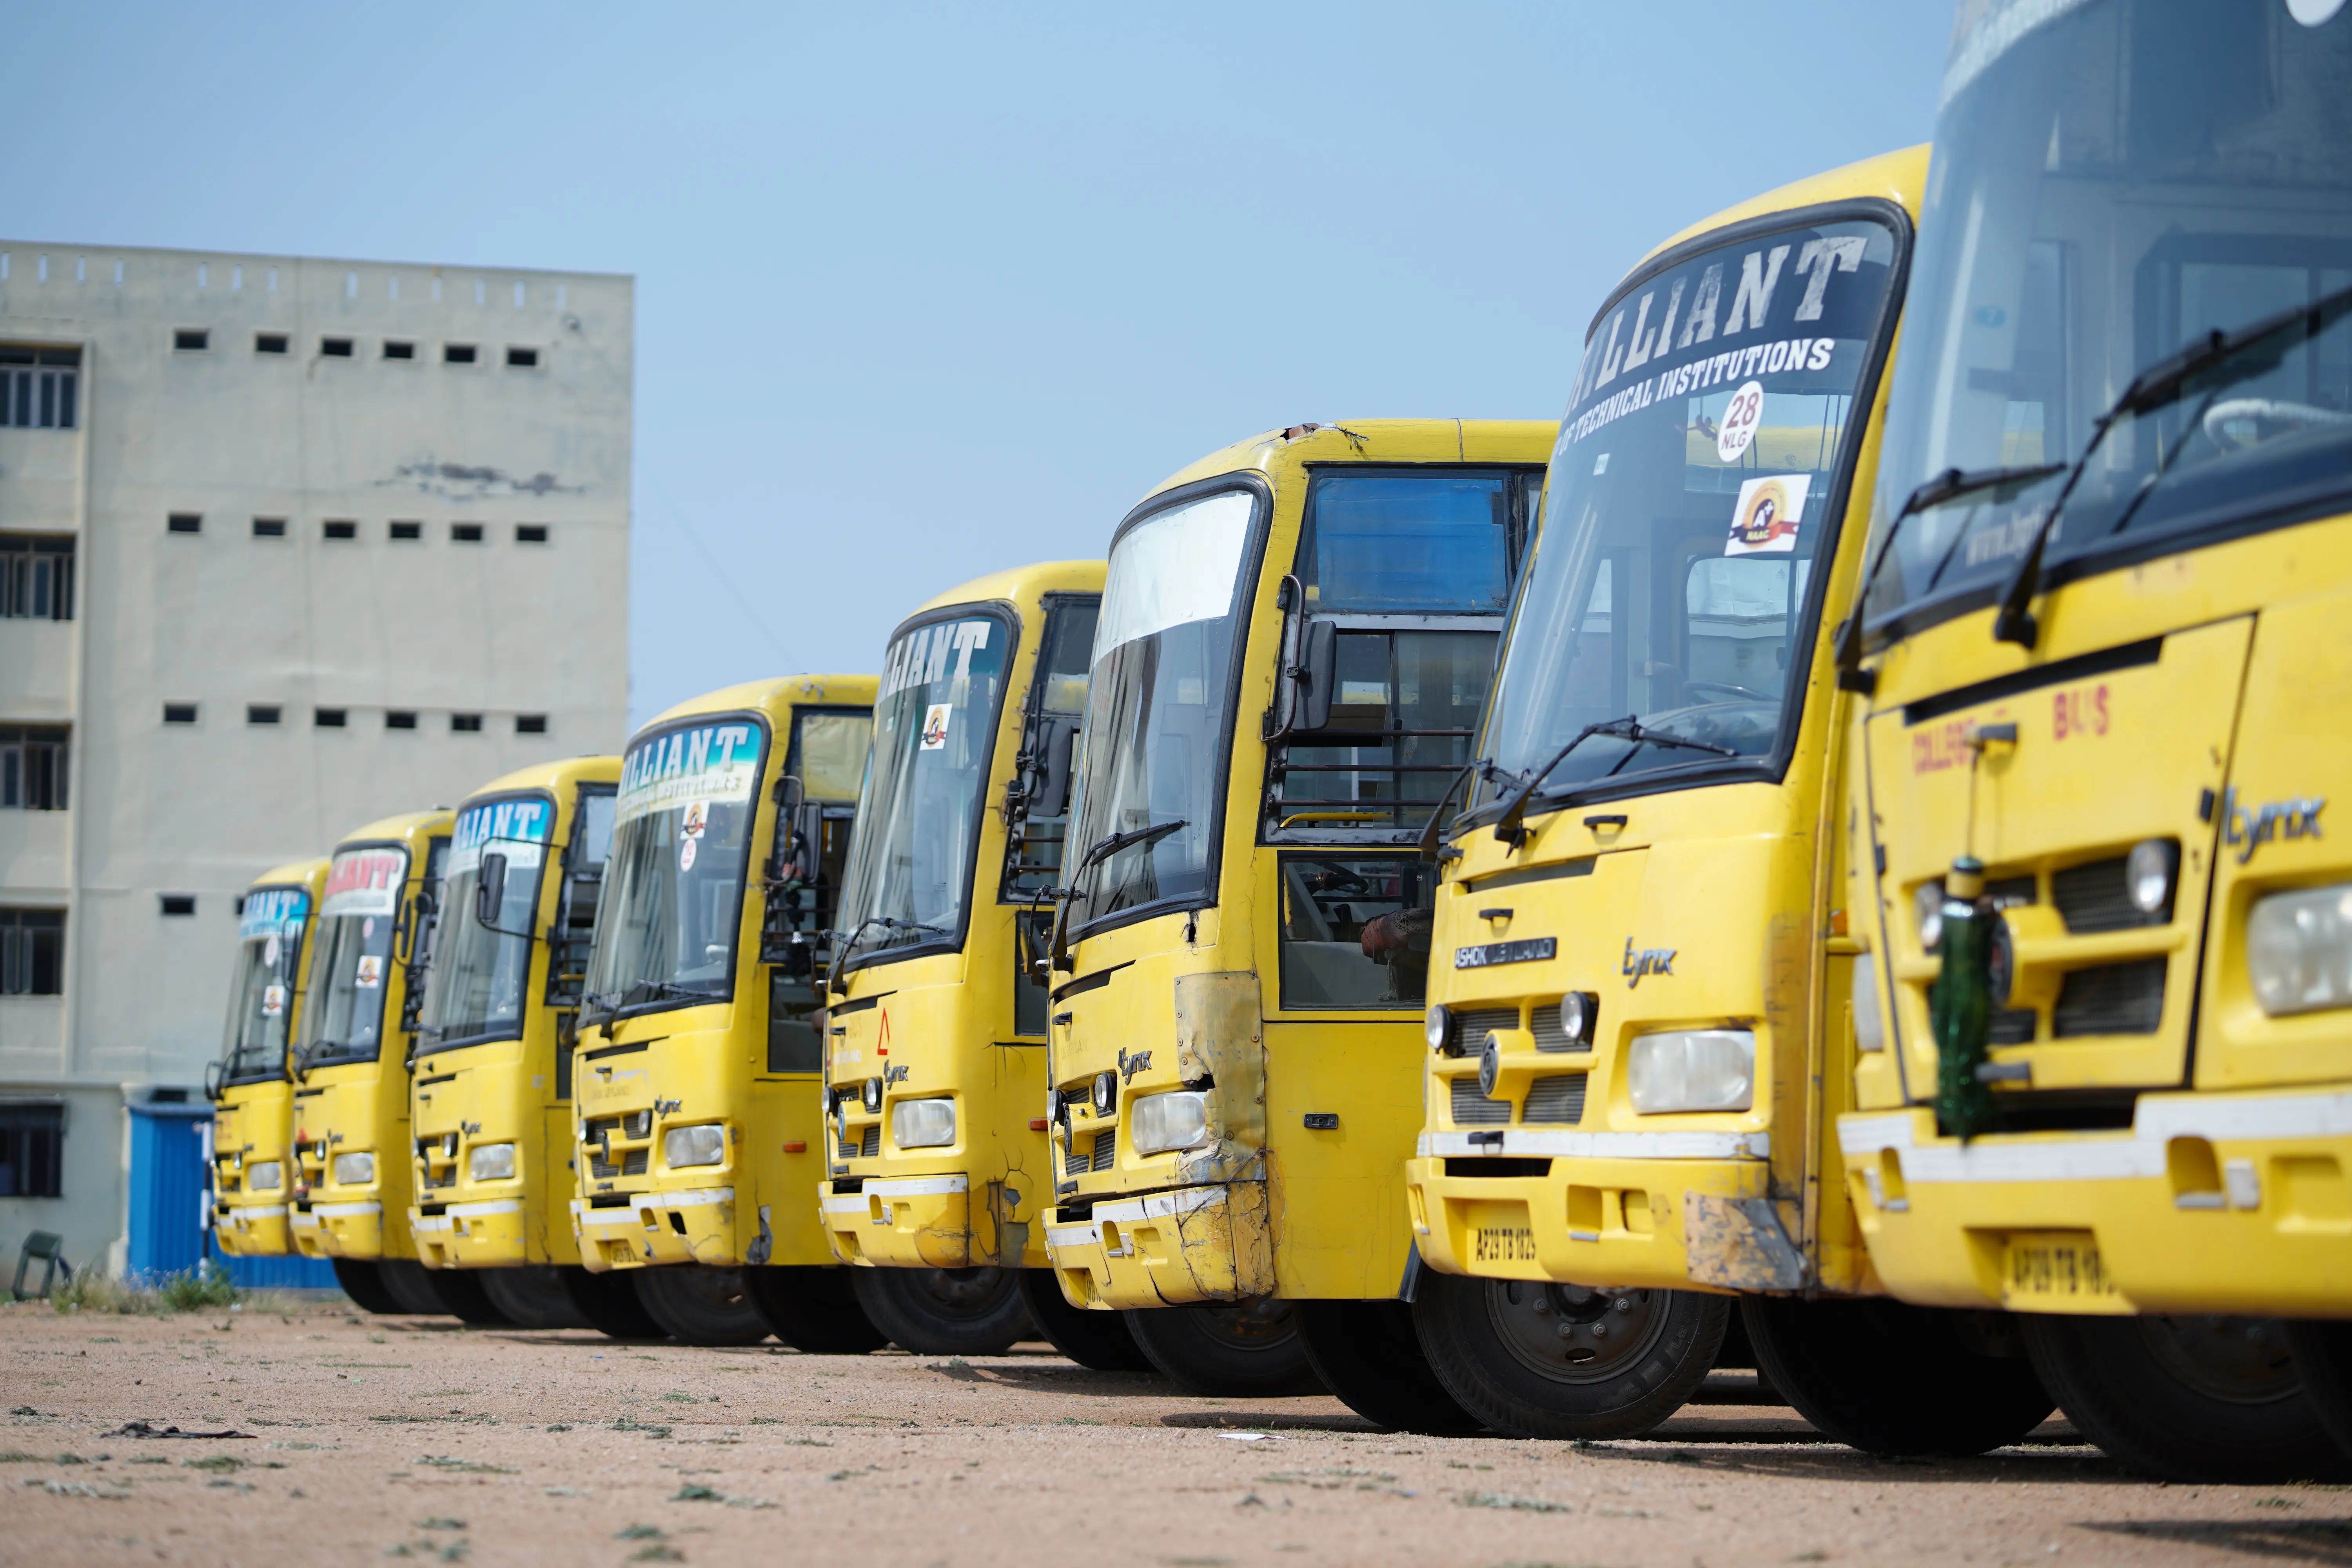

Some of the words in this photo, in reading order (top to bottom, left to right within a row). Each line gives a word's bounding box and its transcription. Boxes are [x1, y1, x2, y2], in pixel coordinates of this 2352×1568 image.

[1574, 378, 1652, 443] TECHNICAL
[1656, 338, 1835, 402] INSTITUTIONS
[1726, 392, 1759, 429] 28
[1721, 431, 1747, 450] NLG
[1753, 500, 1774, 526] A+
[1746, 528, 1770, 541] NAAC
[2053, 684, 2109, 742] BUS
[1455, 946, 1487, 968] ASHOK
